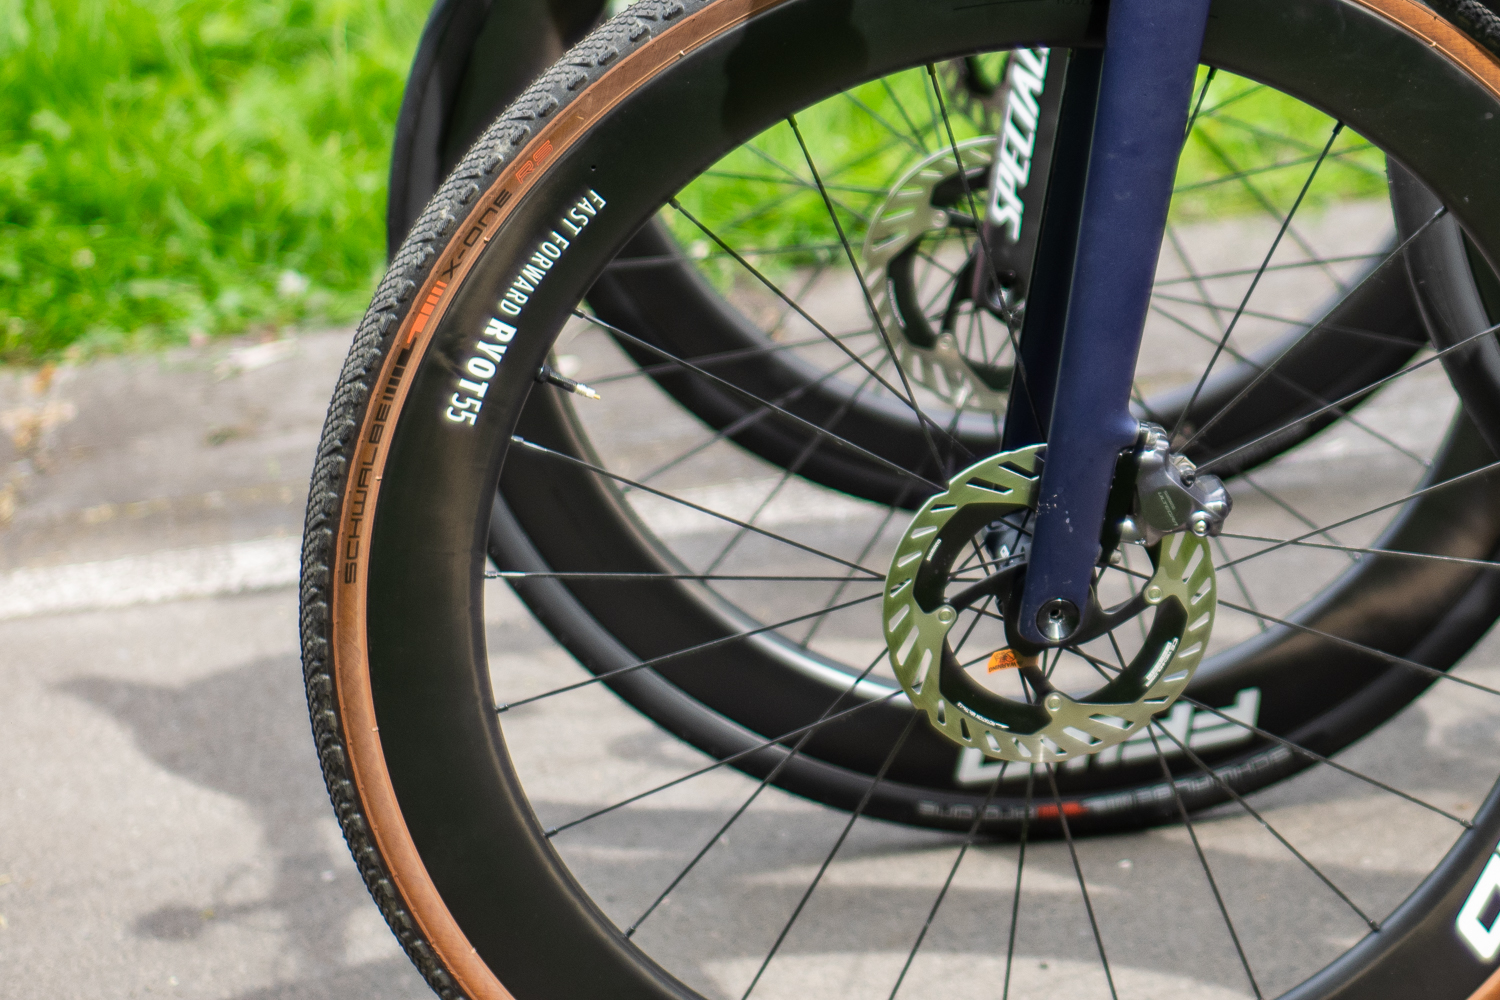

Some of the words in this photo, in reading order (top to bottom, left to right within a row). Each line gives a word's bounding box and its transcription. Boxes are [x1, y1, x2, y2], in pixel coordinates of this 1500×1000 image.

[515, 139, 554, 185] RS
[441, 188, 513, 281] X-ONE
[562, 189, 607, 237] FAST
[499, 229, 570, 316] FORWARD
[446, 317, 518, 427] RYOT55
[345, 402, 392, 585] SCHWALBE
